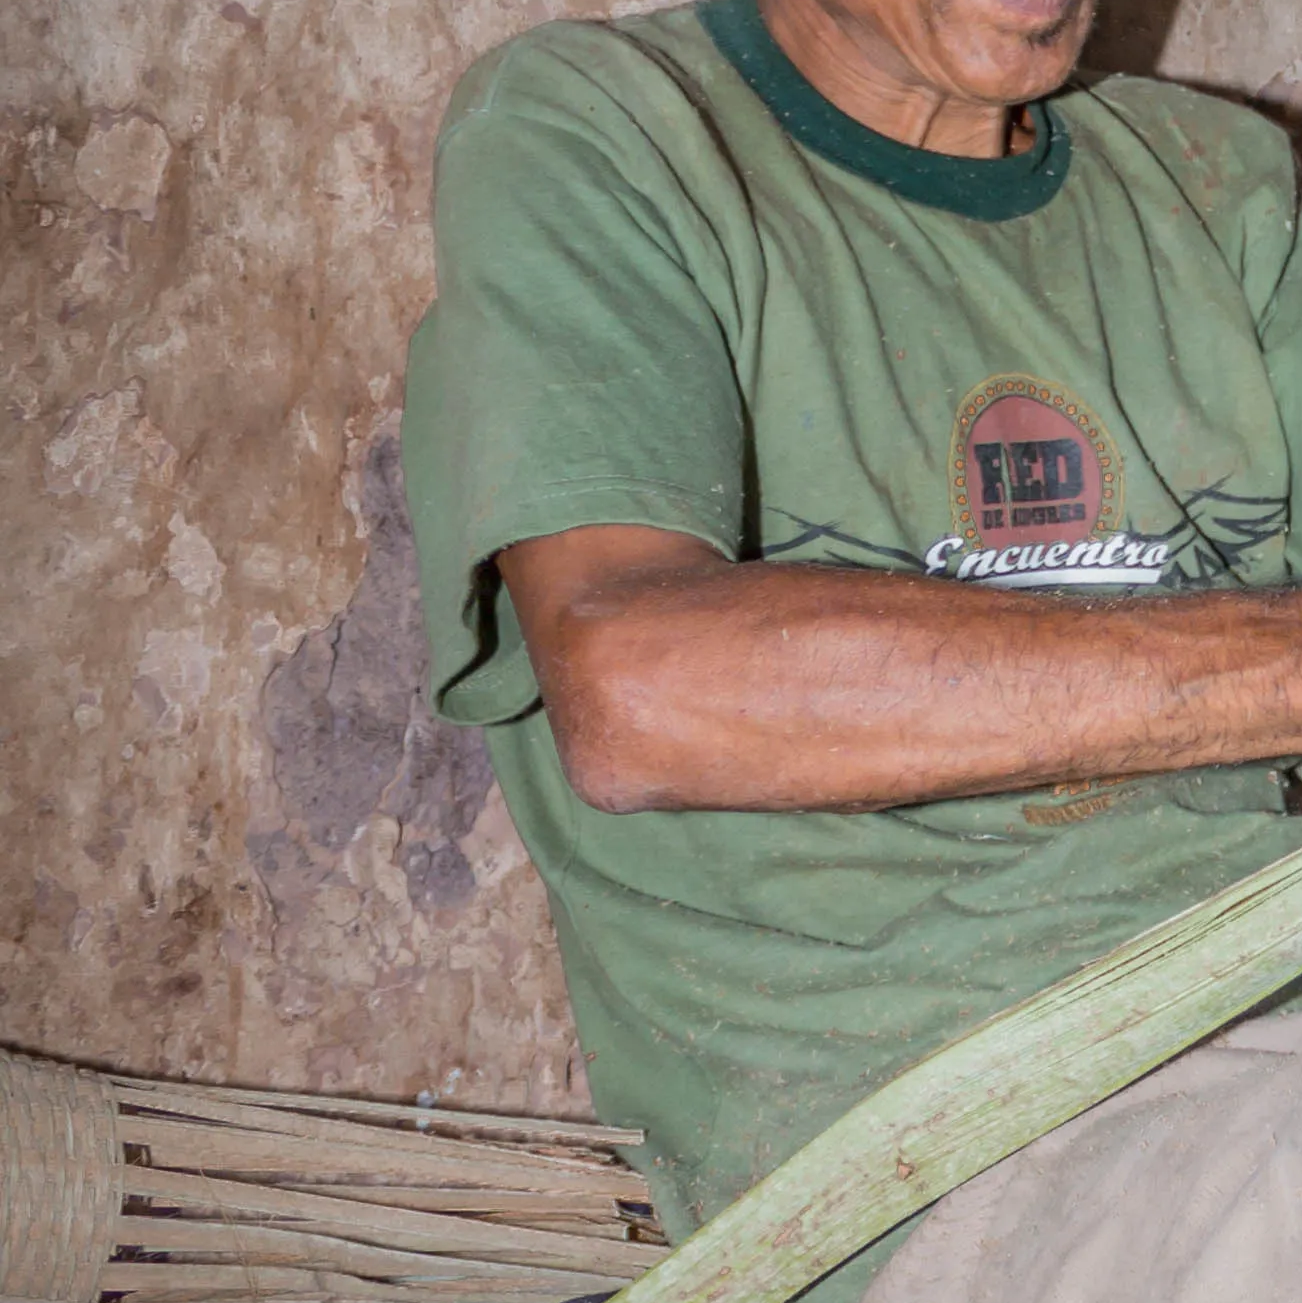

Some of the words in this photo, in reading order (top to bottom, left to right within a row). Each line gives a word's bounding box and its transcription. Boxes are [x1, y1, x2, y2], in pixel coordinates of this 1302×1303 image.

[974, 439, 1084, 504] RED
[982, 508, 1005, 530] DE
[924, 532, 1169, 580] Encuentro
